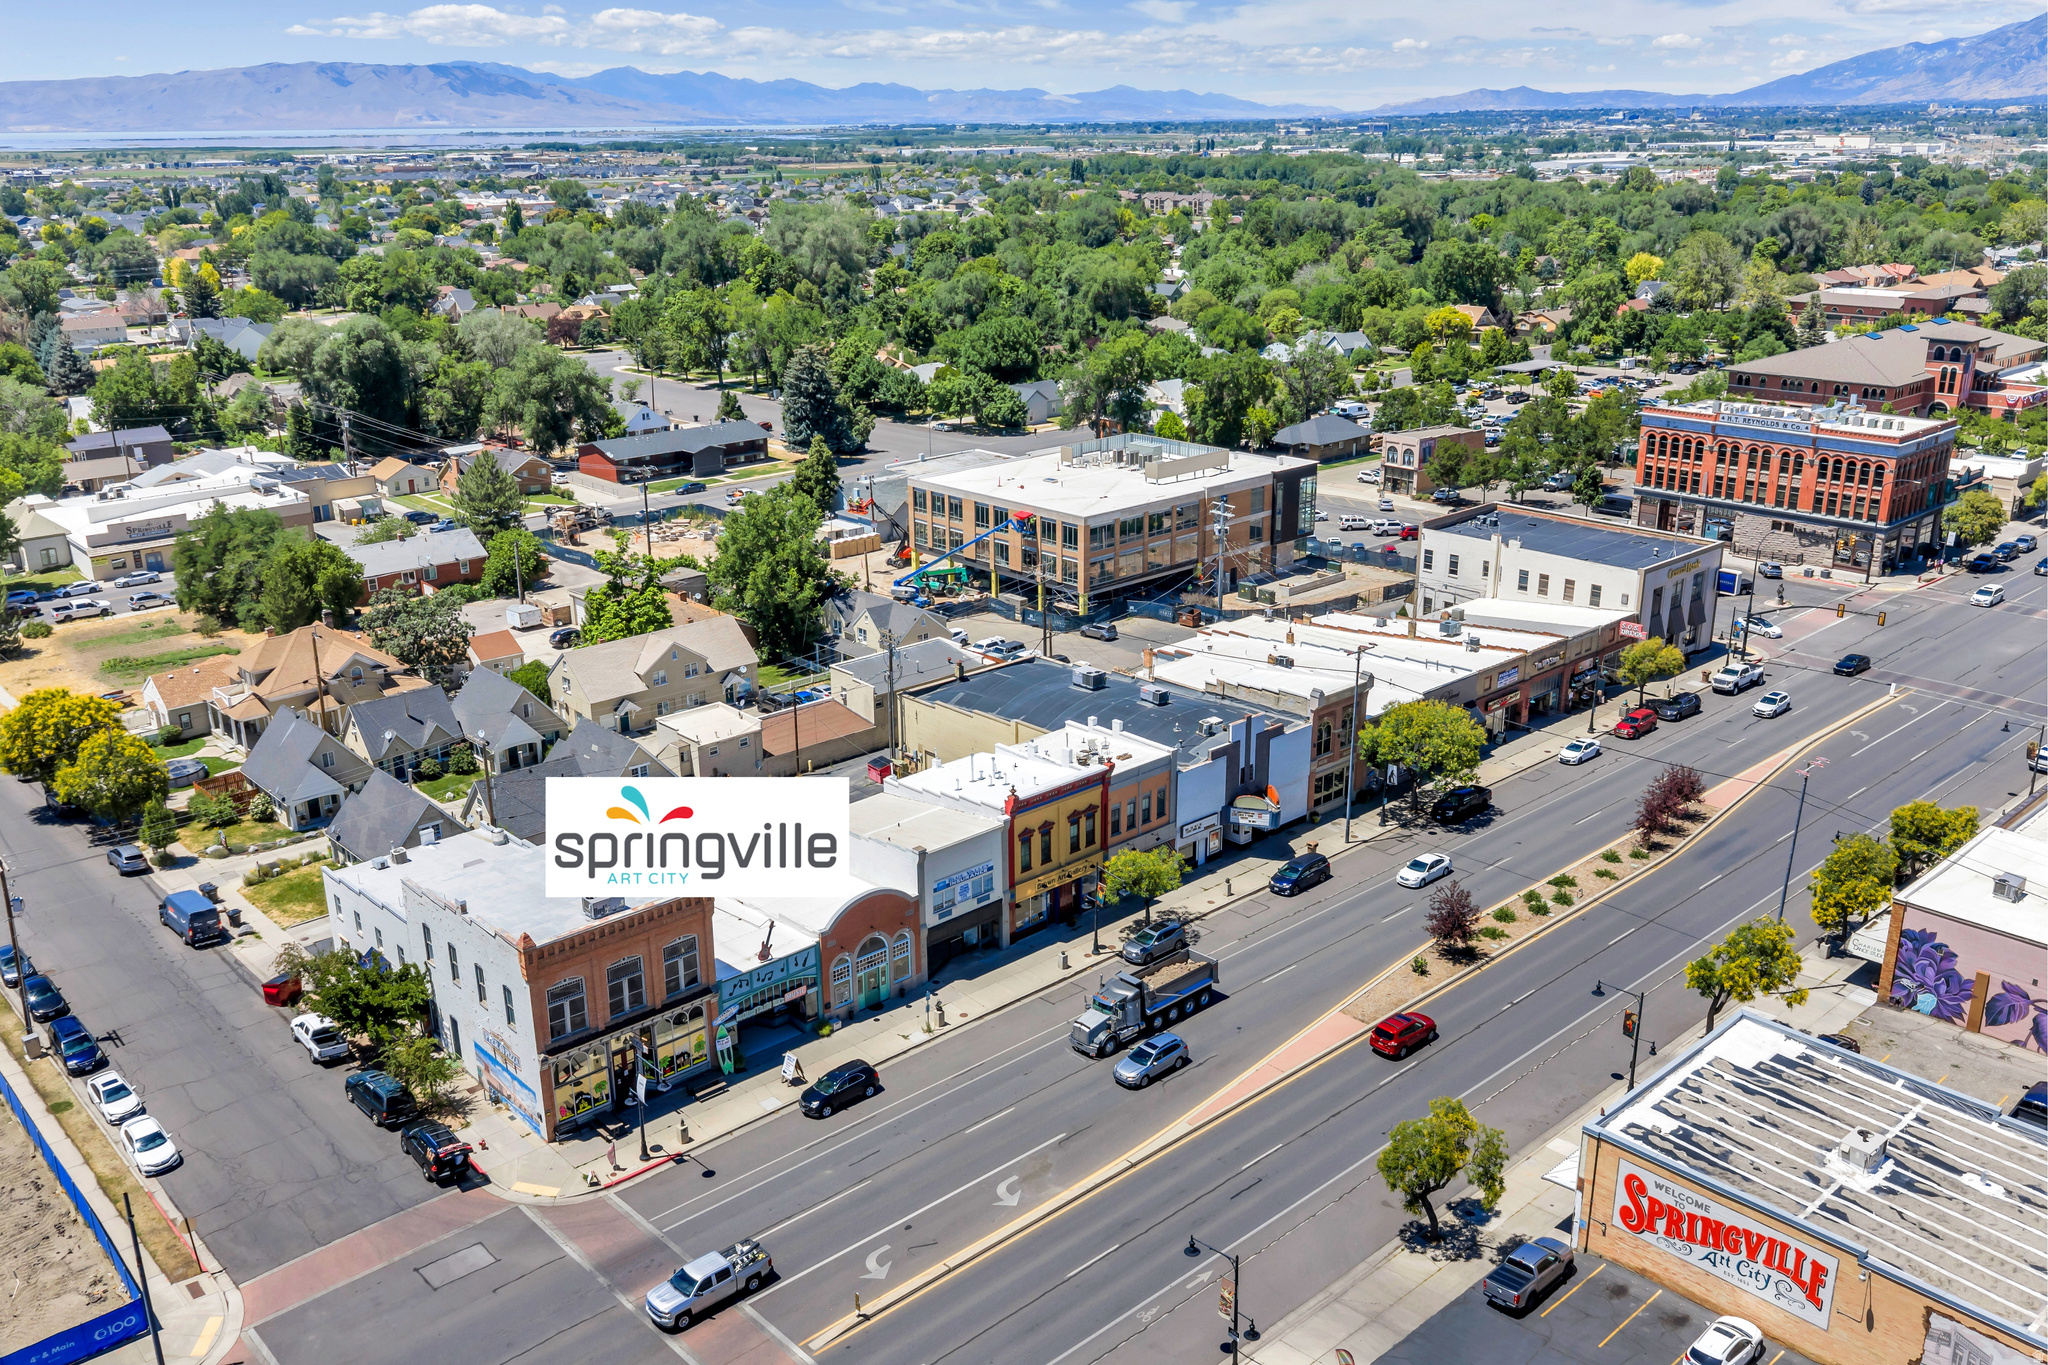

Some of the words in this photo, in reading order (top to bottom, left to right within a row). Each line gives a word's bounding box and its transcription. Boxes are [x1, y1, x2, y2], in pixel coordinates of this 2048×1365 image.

[1742, 417, 1780, 427] REYNOLDS
[1790, 423, 1803, 431] Co.
[126, 521, 173, 534] SPRINGVILLE
[1620, 628, 1643, 637] DRUGS
[966, 863, 990, 875] VALLEY
[949, 868, 988, 886] INSURANCE
[1058, 873, 1067, 881] Art
[786, 987, 805, 1000] MUSIC
[1654, 1180, 1711, 1214] WELCOME
[1674, 1199, 1686, 1210] TO
[1619, 1173, 1828, 1311] SPRINGVILLE
[1698, 1251, 1731, 1268] Art
[1736, 1260, 1772, 1290] City
[1723, 1270, 1736, 1280] EST.
[51, 1341, 75, 1355] Main
